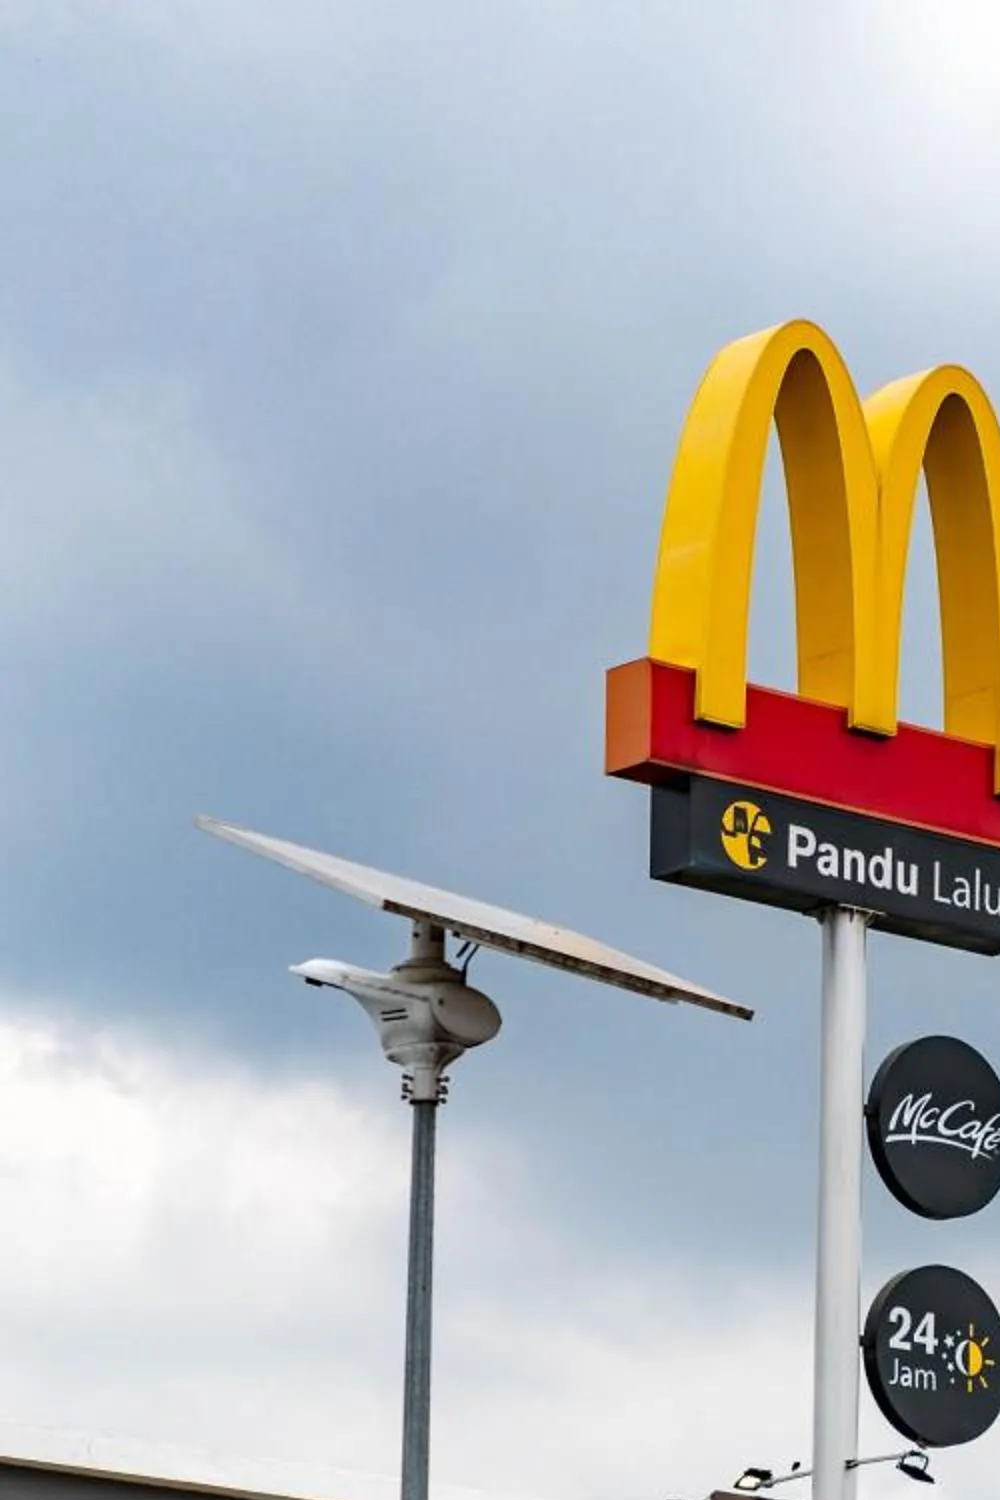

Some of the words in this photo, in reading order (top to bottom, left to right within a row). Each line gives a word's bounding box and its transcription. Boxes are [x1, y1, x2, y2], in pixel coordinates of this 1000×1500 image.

[787, 824, 918, 897] Pandu
[889, 1306, 939, 1355] 24
[889, 1358, 938, 1391] Jam
